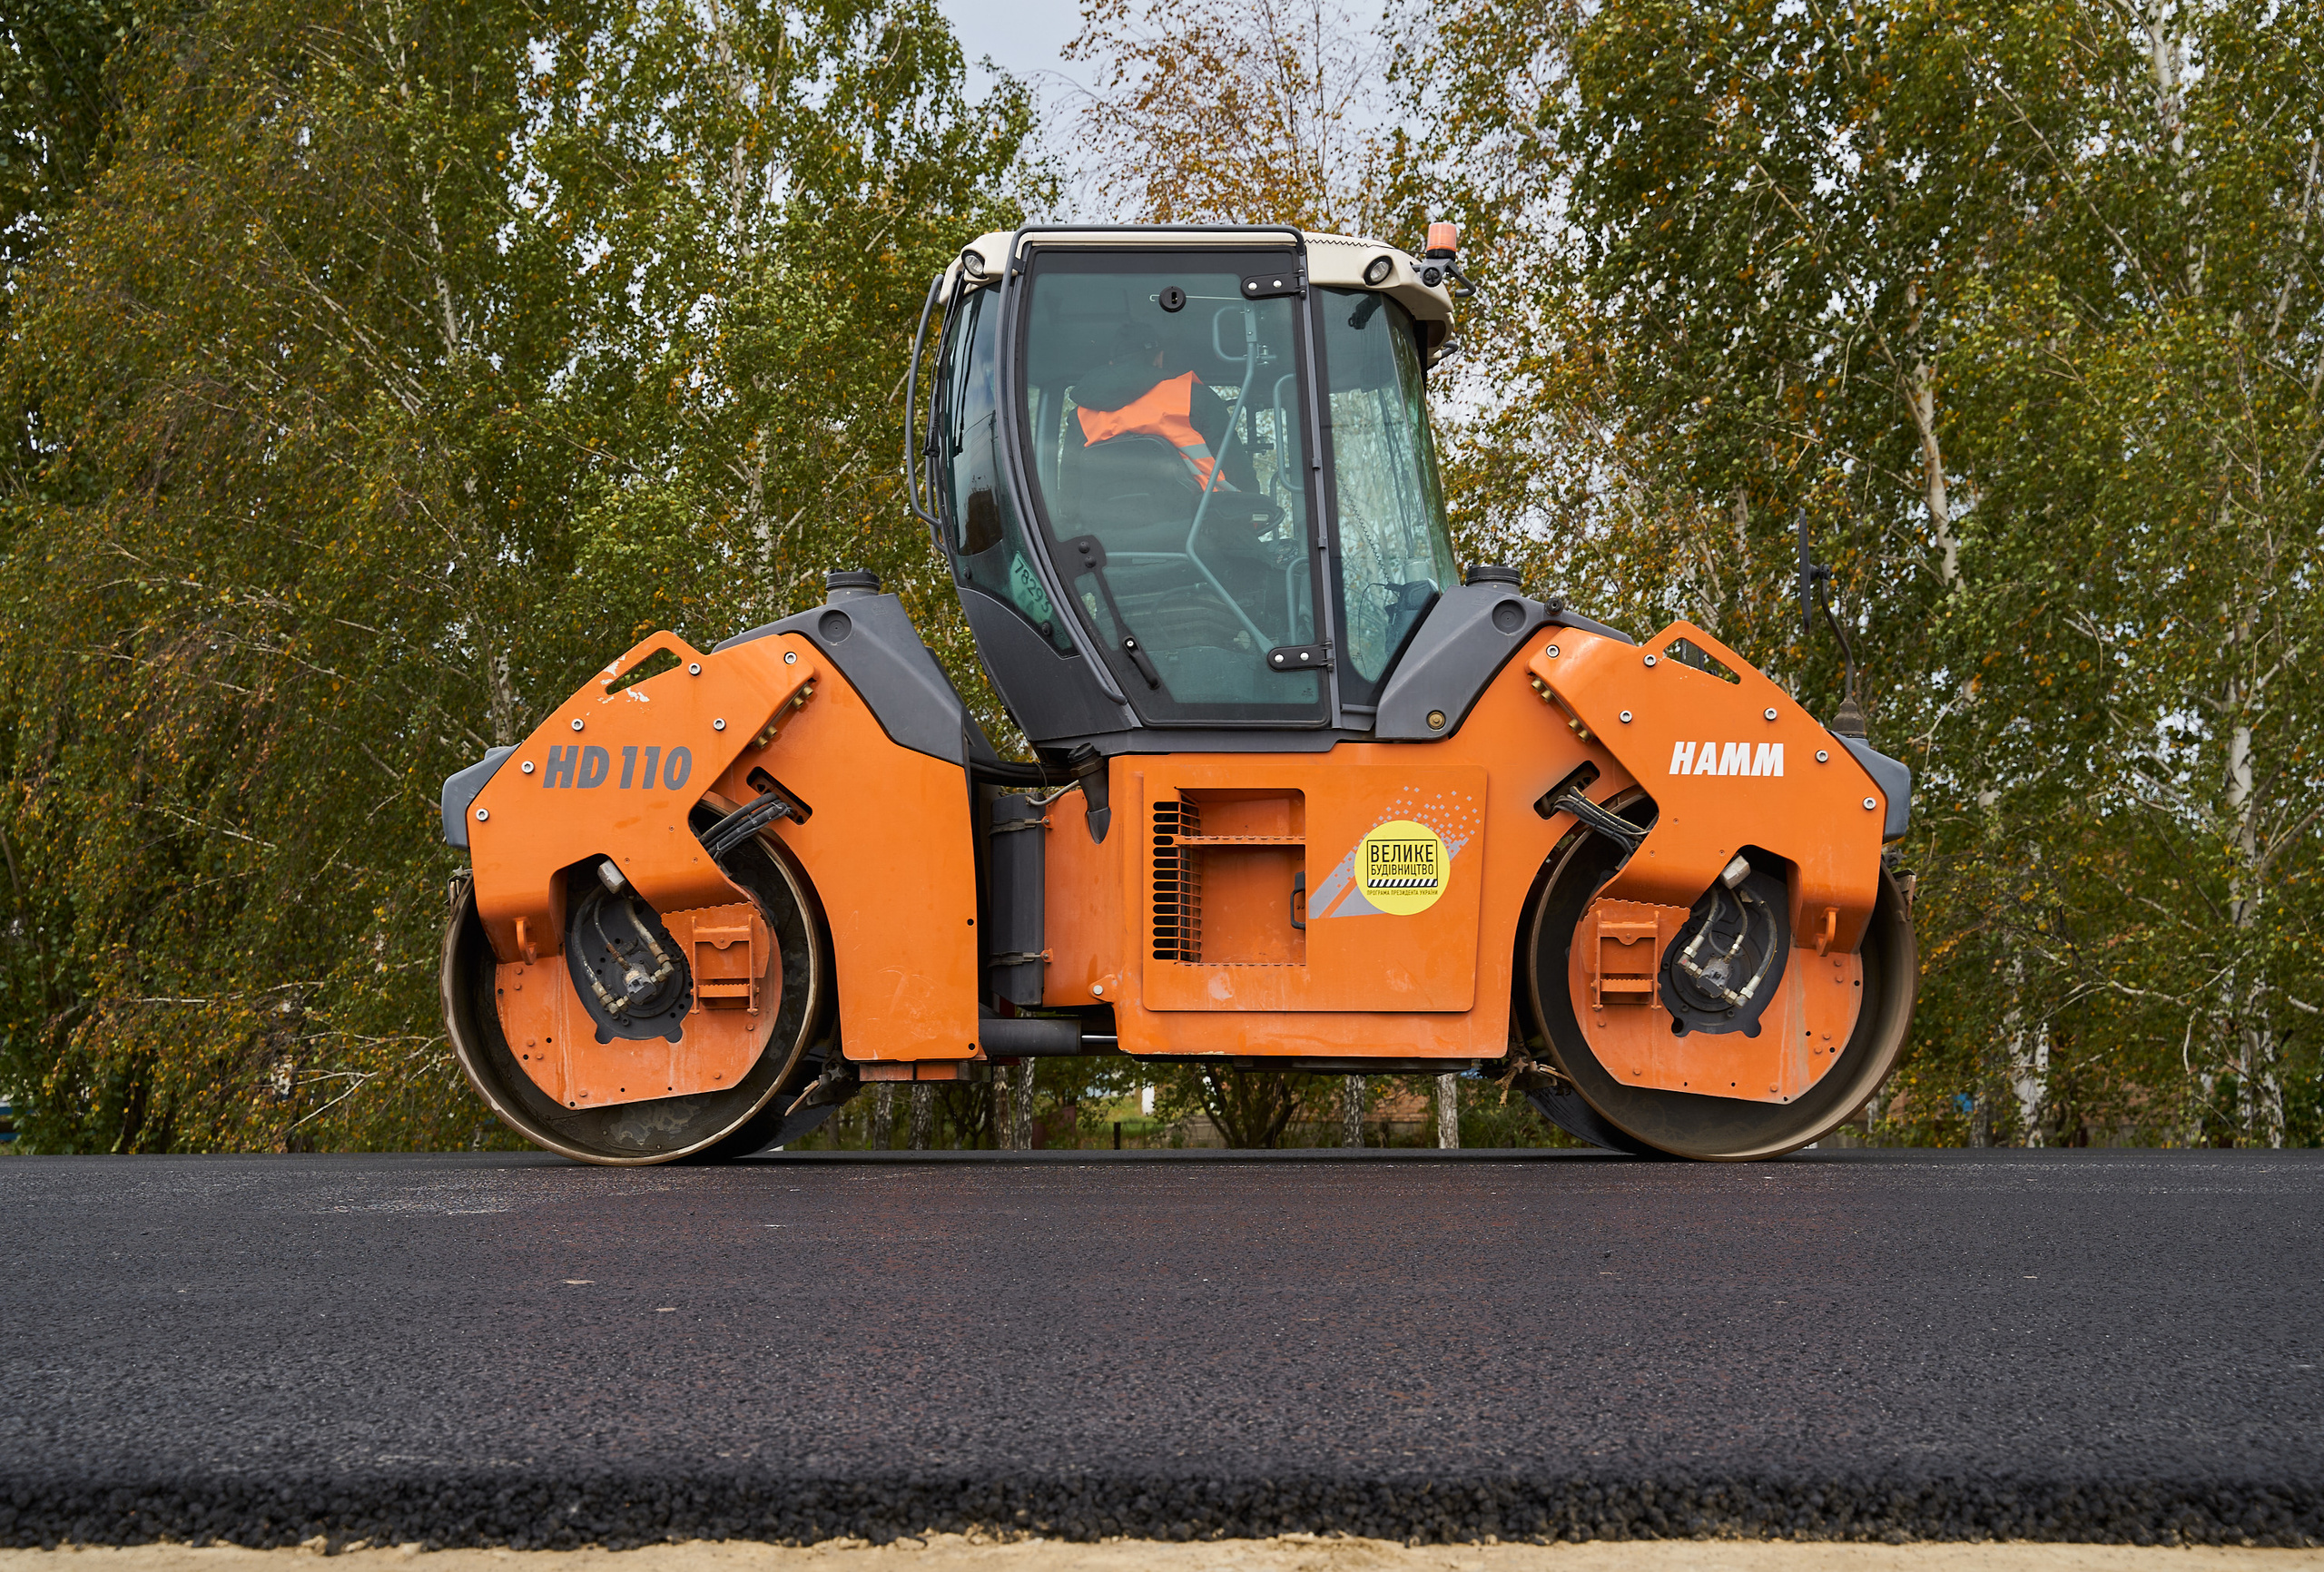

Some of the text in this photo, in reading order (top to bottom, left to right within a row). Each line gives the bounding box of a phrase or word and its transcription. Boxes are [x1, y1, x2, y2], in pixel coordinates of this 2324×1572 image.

[543, 745, 693, 791] HD 110
[1669, 741, 1784, 777] HAMM
[1370, 844, 1434, 863] ВЕЛИКЕ
[1370, 863, 1434, 877] БУДІВНИЦТВО
